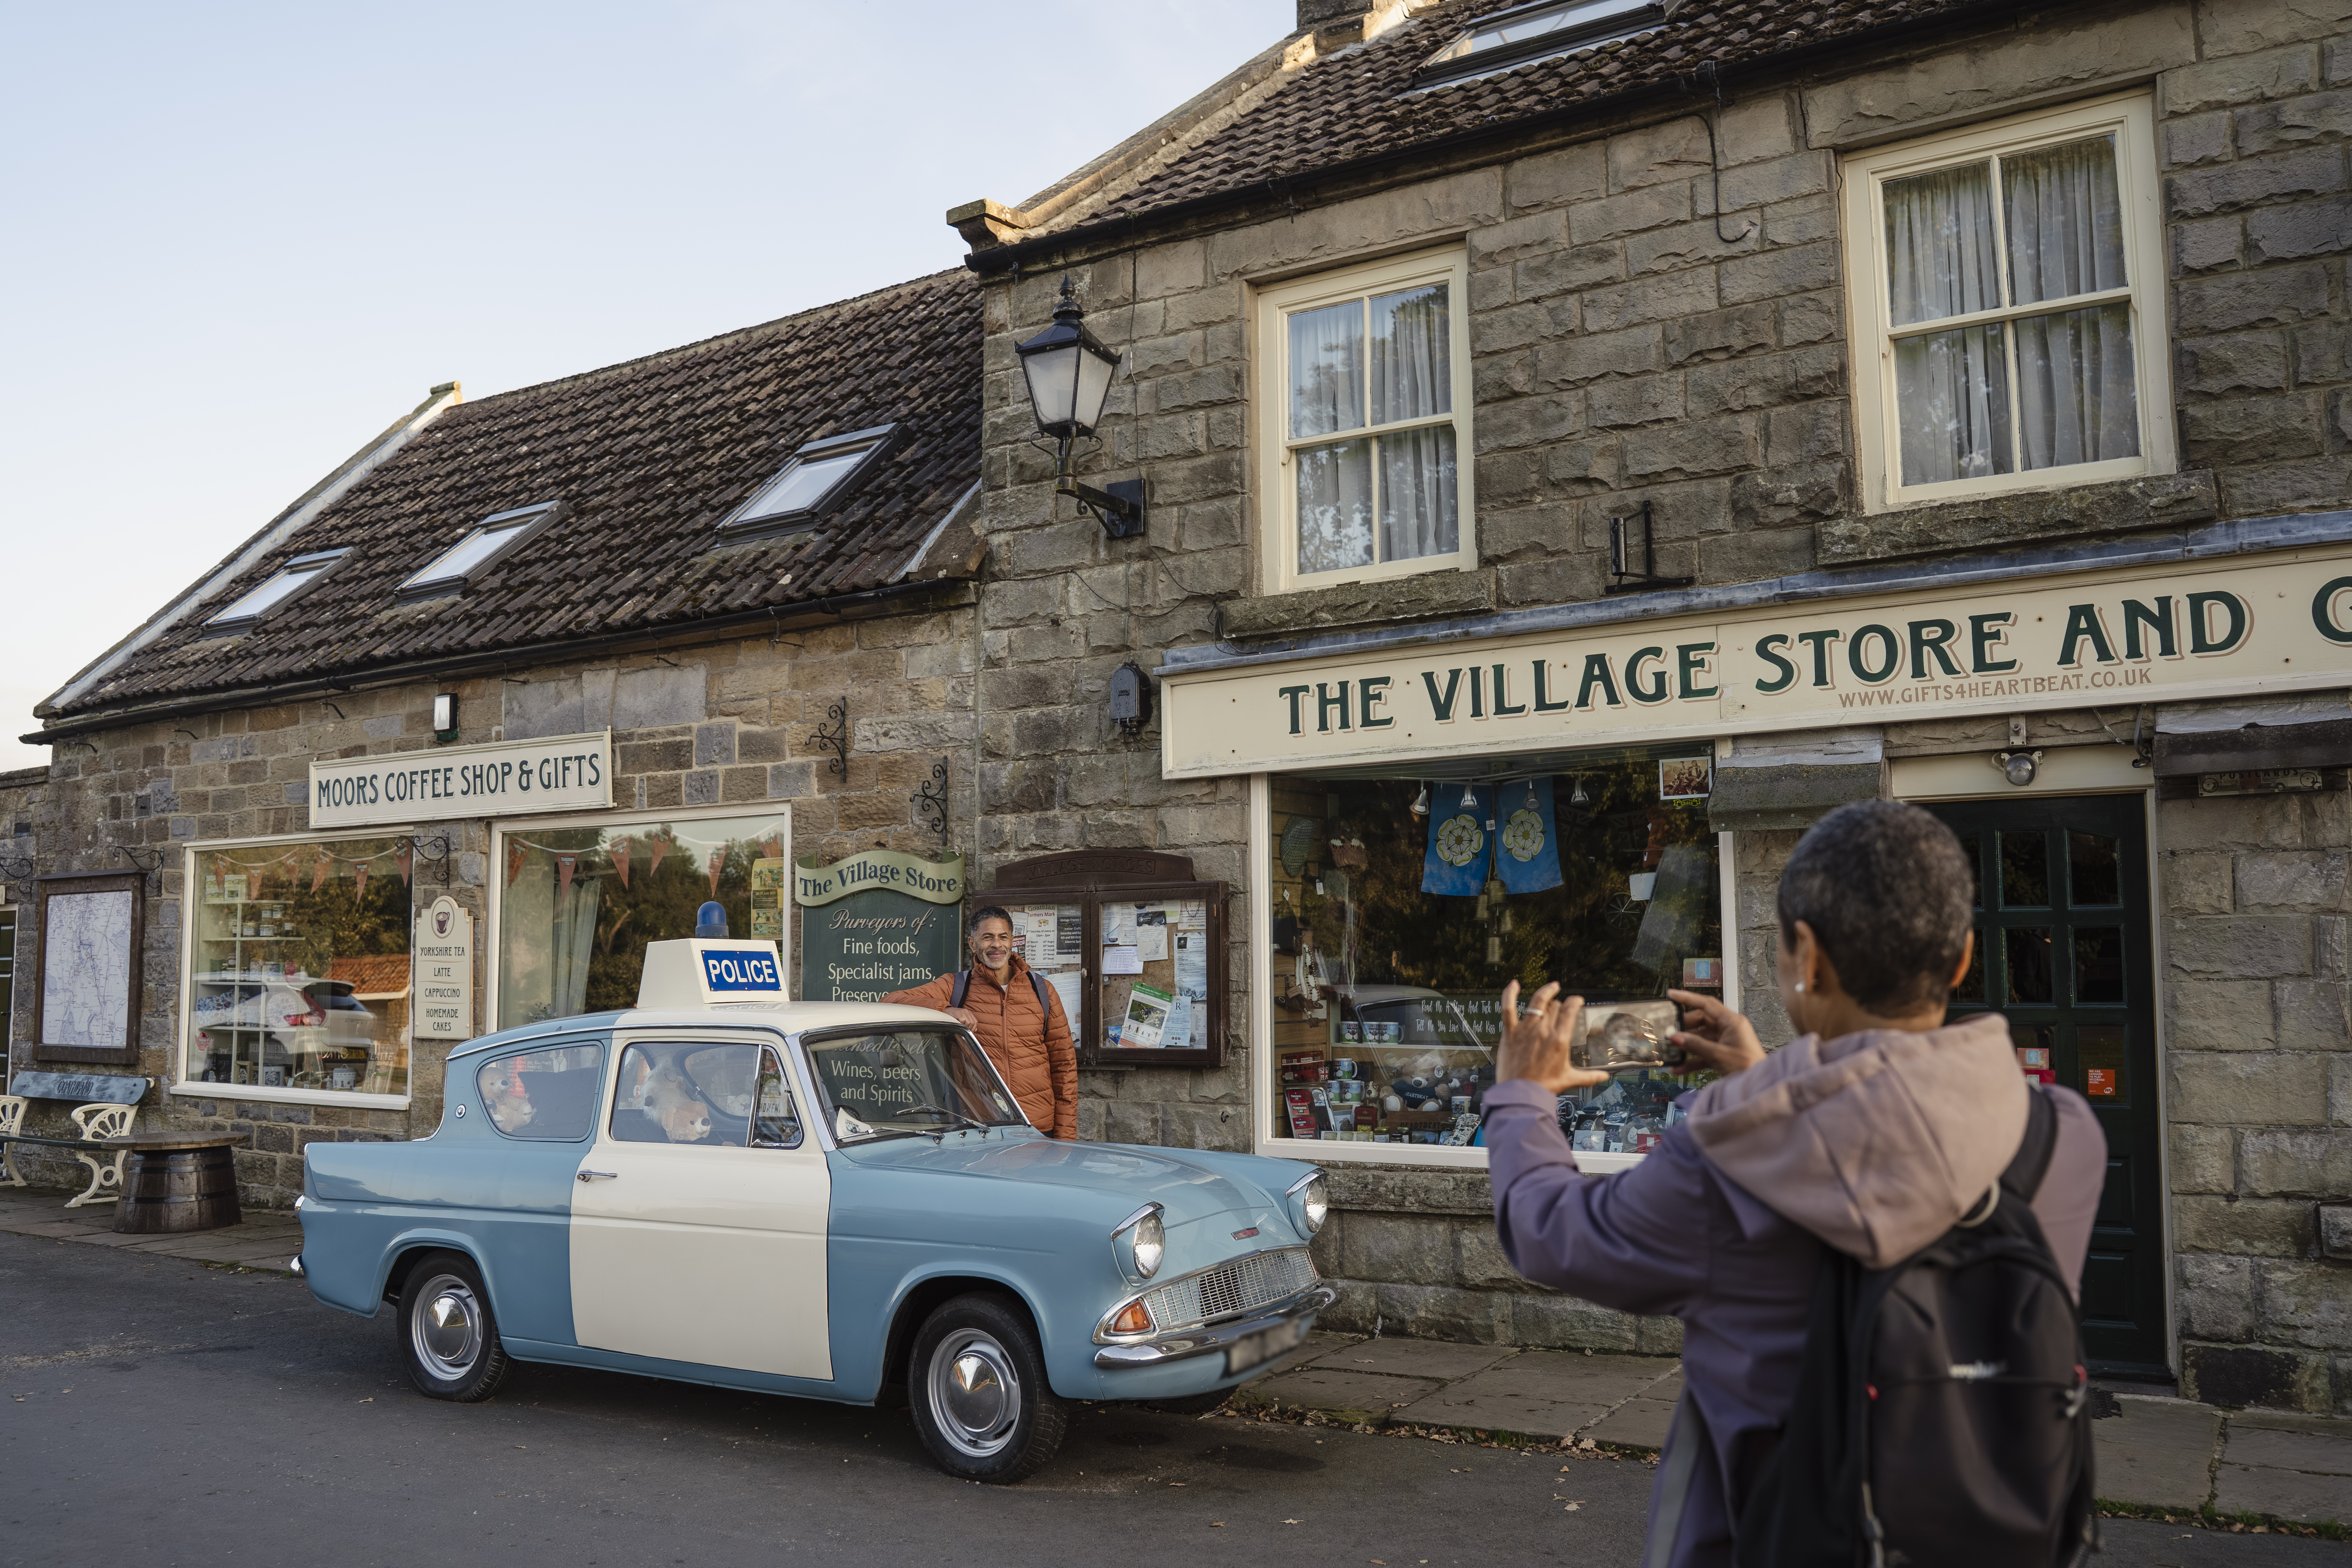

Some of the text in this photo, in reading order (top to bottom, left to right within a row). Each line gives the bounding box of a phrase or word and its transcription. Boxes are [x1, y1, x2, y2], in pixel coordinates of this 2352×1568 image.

[1279, 677, 1394, 735] THE
[1421, 642, 1719, 720] VILLAGE
[1756, 612, 2017, 691] STORE
[2057, 591, 2246, 665] AND
[1838, 668, 2152, 708] WWW.GIFTS4HEARTBEAT.CO.UK
[318, 753, 600, 808] MOORS COFFEE SHOP & GIFTS
[2220, 769, 2299, 780] POSTCARDS
[513, 843, 526, 852] YORKSHIRE
[612, 842, 627, 852] YORKSHIRE
[1029, 858, 1153, 878] VILLAGE NOTICES
[799, 860, 957, 897] The Village Store
[829, 909, 907, 935] Purveyors
[420, 947, 465, 956] YORKSHIRE TEA
[844, 936, 920, 957] Fine foods,
[434, 967, 451, 976] LATTE
[708, 960, 776, 983] POLICE
[828, 962, 936, 985] Specialist jams,
[425, 988, 460, 998] CAPPUCCINO
[426, 1008, 458, 1018] HOMEMADE
[1176, 1002, 1181, 1010] R
[1422, 1000, 1433, 1013] Read
[1436, 1000, 1443, 1014] Me
[1446, 1000, 1450, 1014] A
[1454, 1000, 1465, 1016] Story
[1468, 1000, 1478, 1014] And
[1481, 1000, 1492, 1014] Tuck
[1495, 1000, 1502, 1014] Me
[433, 1022, 451, 1031] CAKES
[1416, 1020, 1425, 1032] Tell
[1428, 1020, 1435, 1033] Me
[1438, 1020, 1446, 1033] You
[1449, 1020, 1459, 1033] Love
[1463, 1020, 1469, 1033] Me
[1473, 1020, 1483, 1034] And
[1486, 1020, 1495, 1034] Kiss
[370, 1052, 394, 1061] LATTE
[831, 1060, 920, 1081] Wines, Beers
[57, 1079, 94, 1095] GOATHLAND
[841, 1083, 913, 1106] and Spirits
